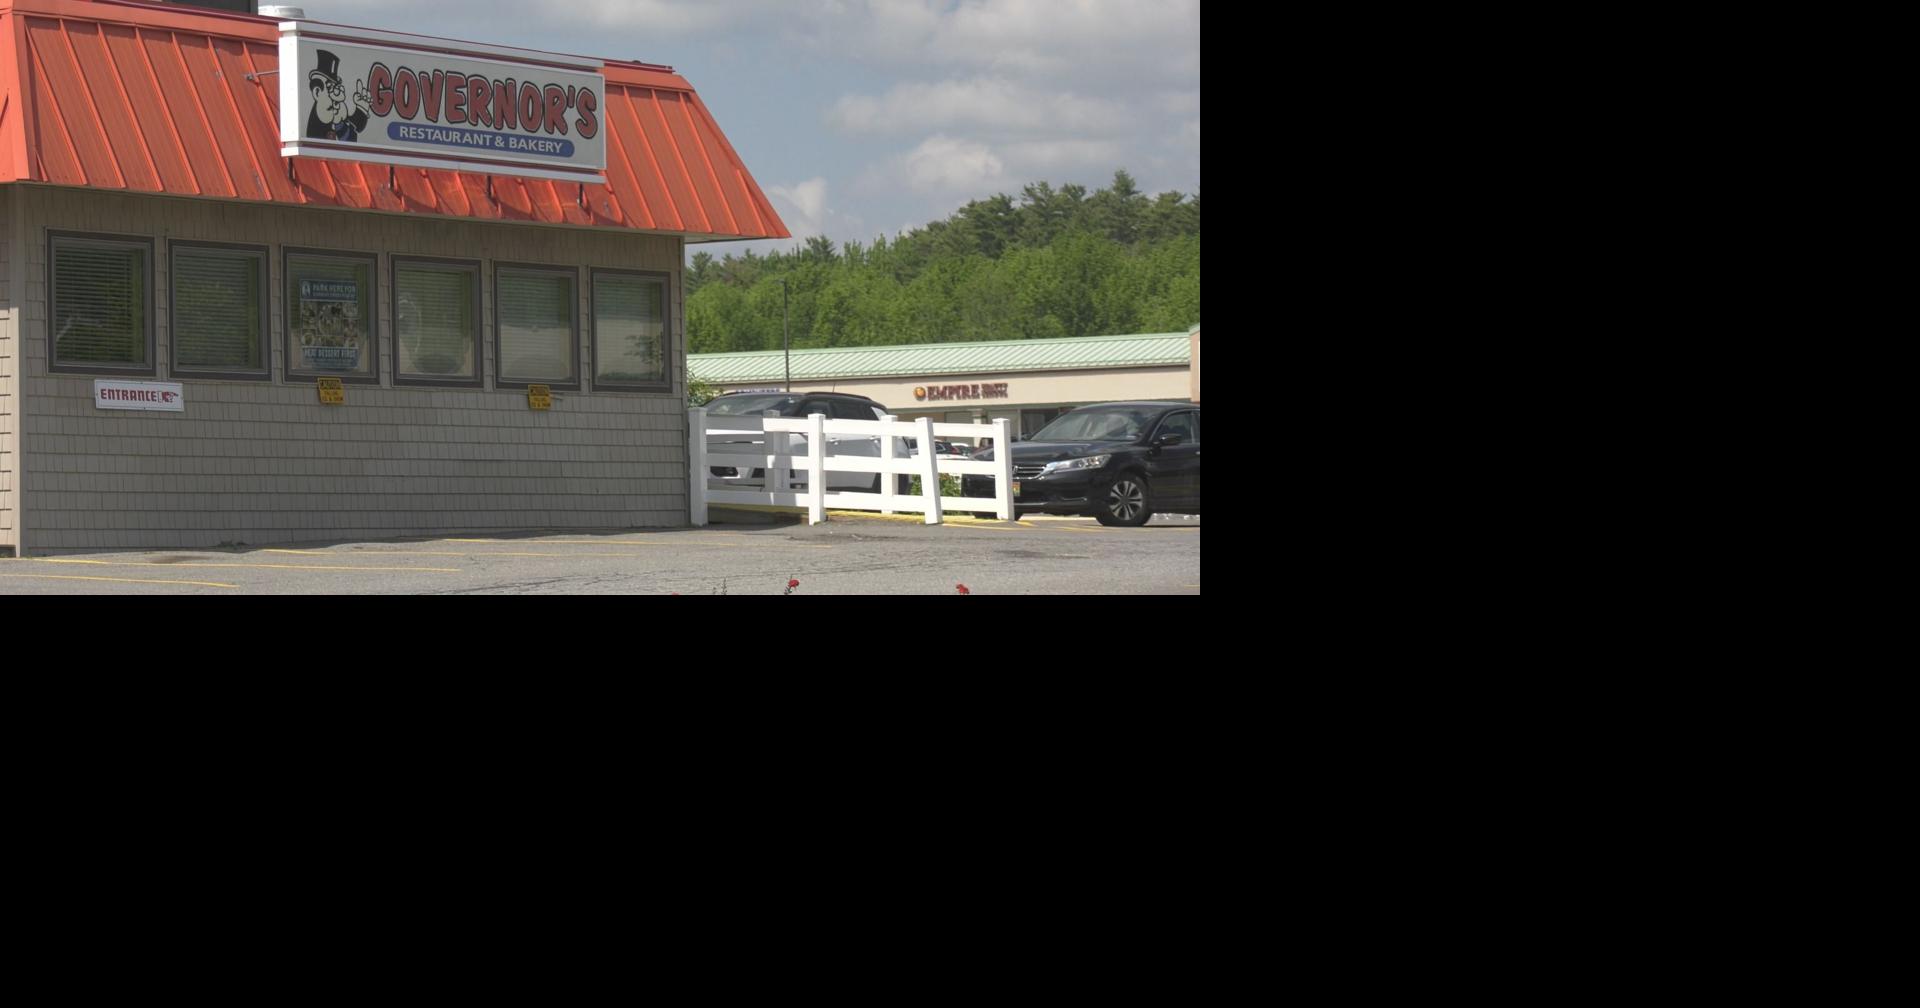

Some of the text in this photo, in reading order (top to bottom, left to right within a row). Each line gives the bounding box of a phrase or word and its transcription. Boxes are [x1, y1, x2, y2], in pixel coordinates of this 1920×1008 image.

[367, 62, 598, 139] GOVERNOR'S
[400, 126, 563, 154] RESTAURANT & BAKERY
[100, 388, 157, 402] ENTRANCE
[927, 384, 980, 401] EMPIRE
